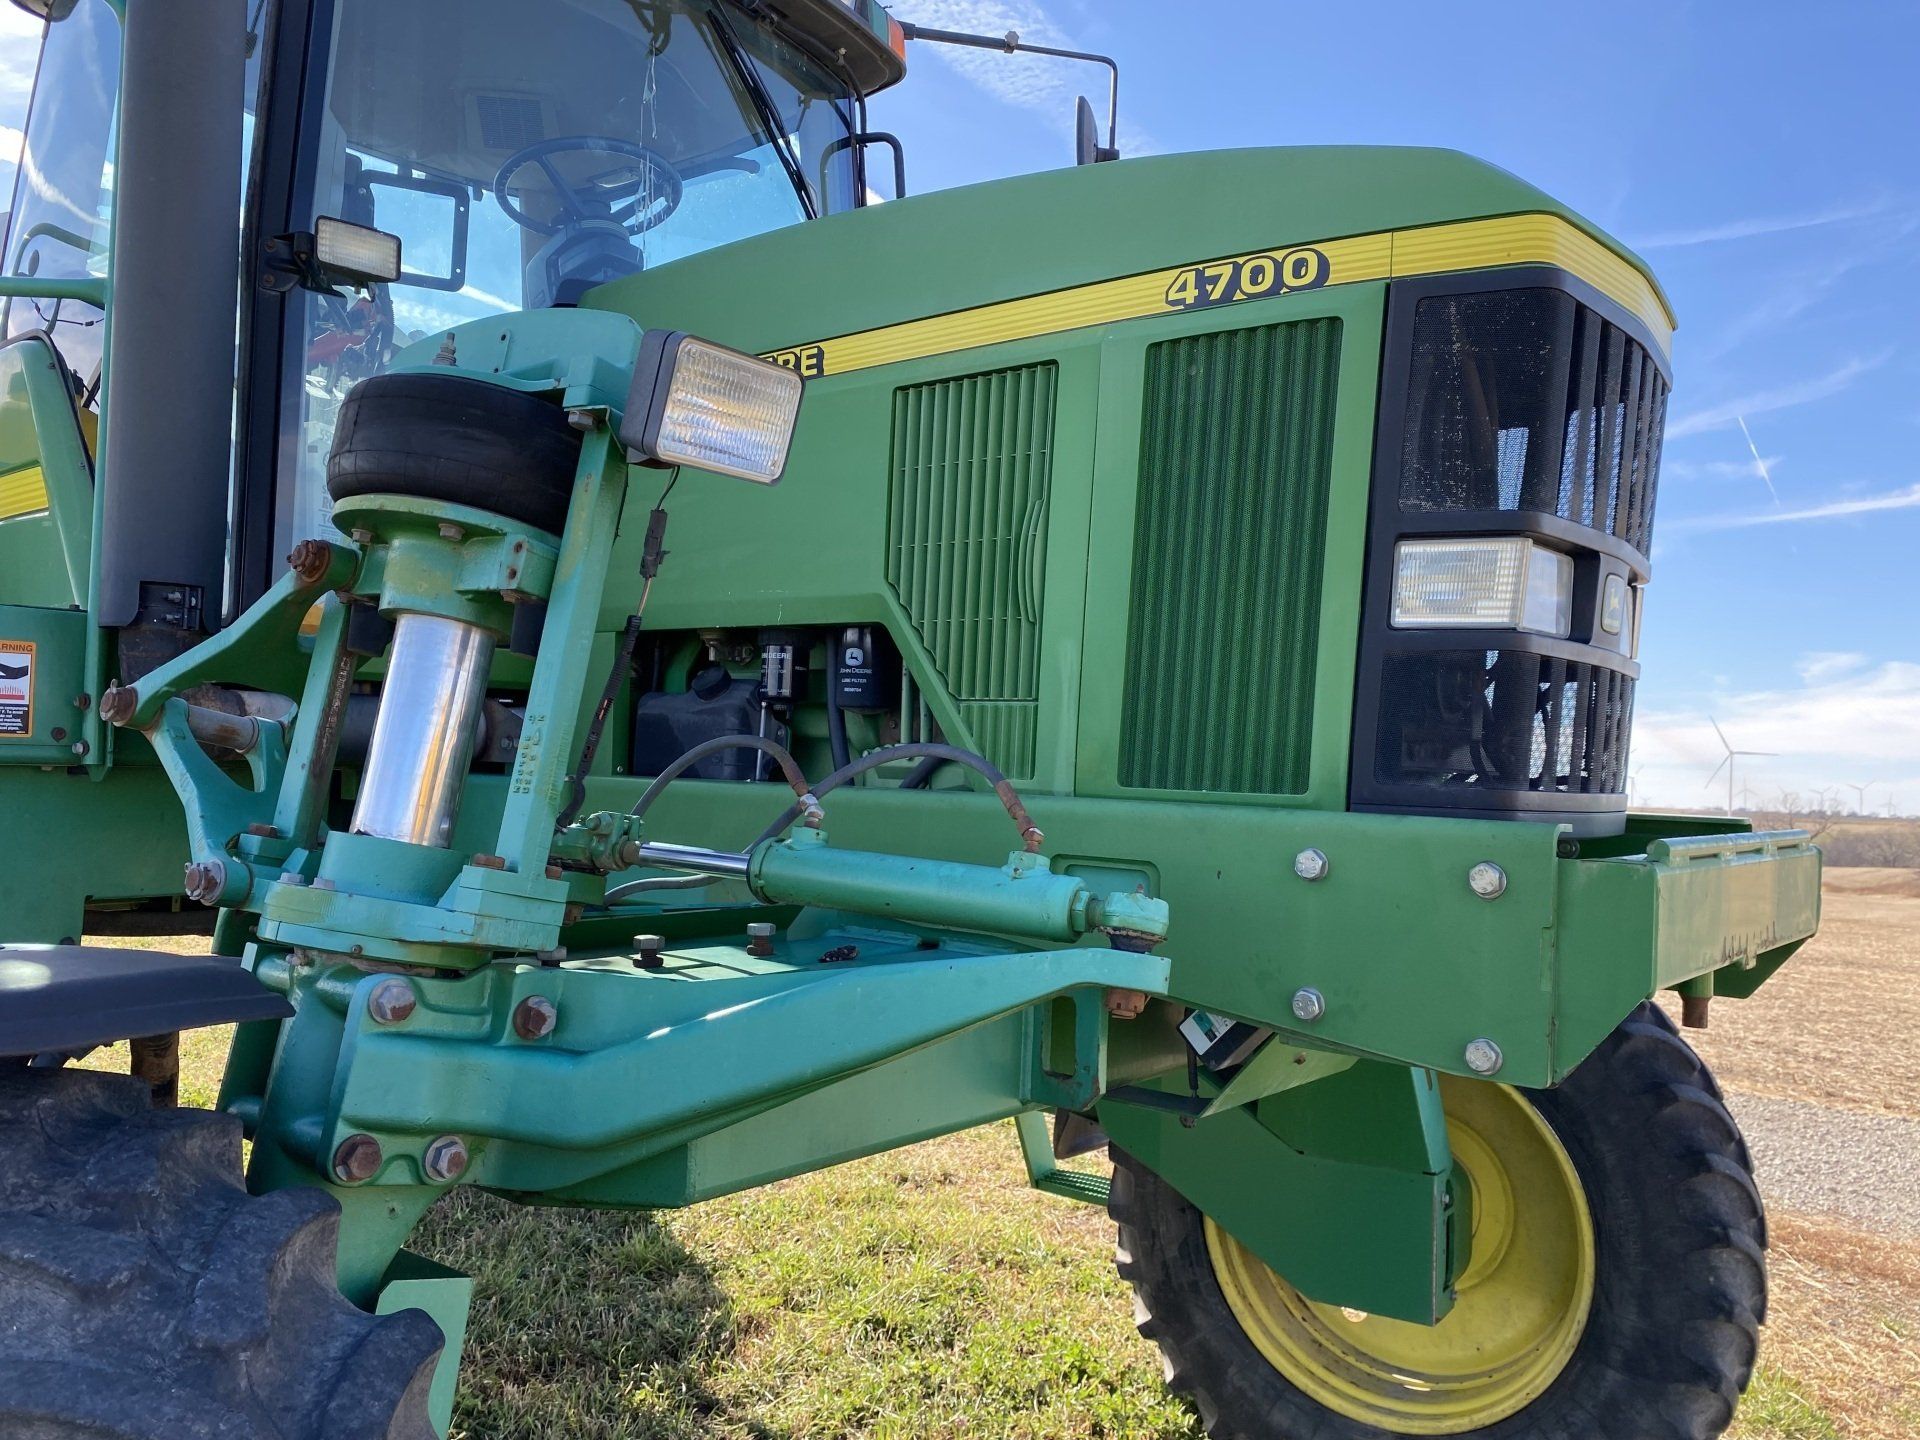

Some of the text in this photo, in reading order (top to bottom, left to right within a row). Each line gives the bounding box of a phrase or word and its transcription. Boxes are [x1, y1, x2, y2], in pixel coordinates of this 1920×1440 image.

[1166, 249, 1326, 308] 4700
[764, 344, 822, 377] RE
[0, 643, 33, 652] RNING
